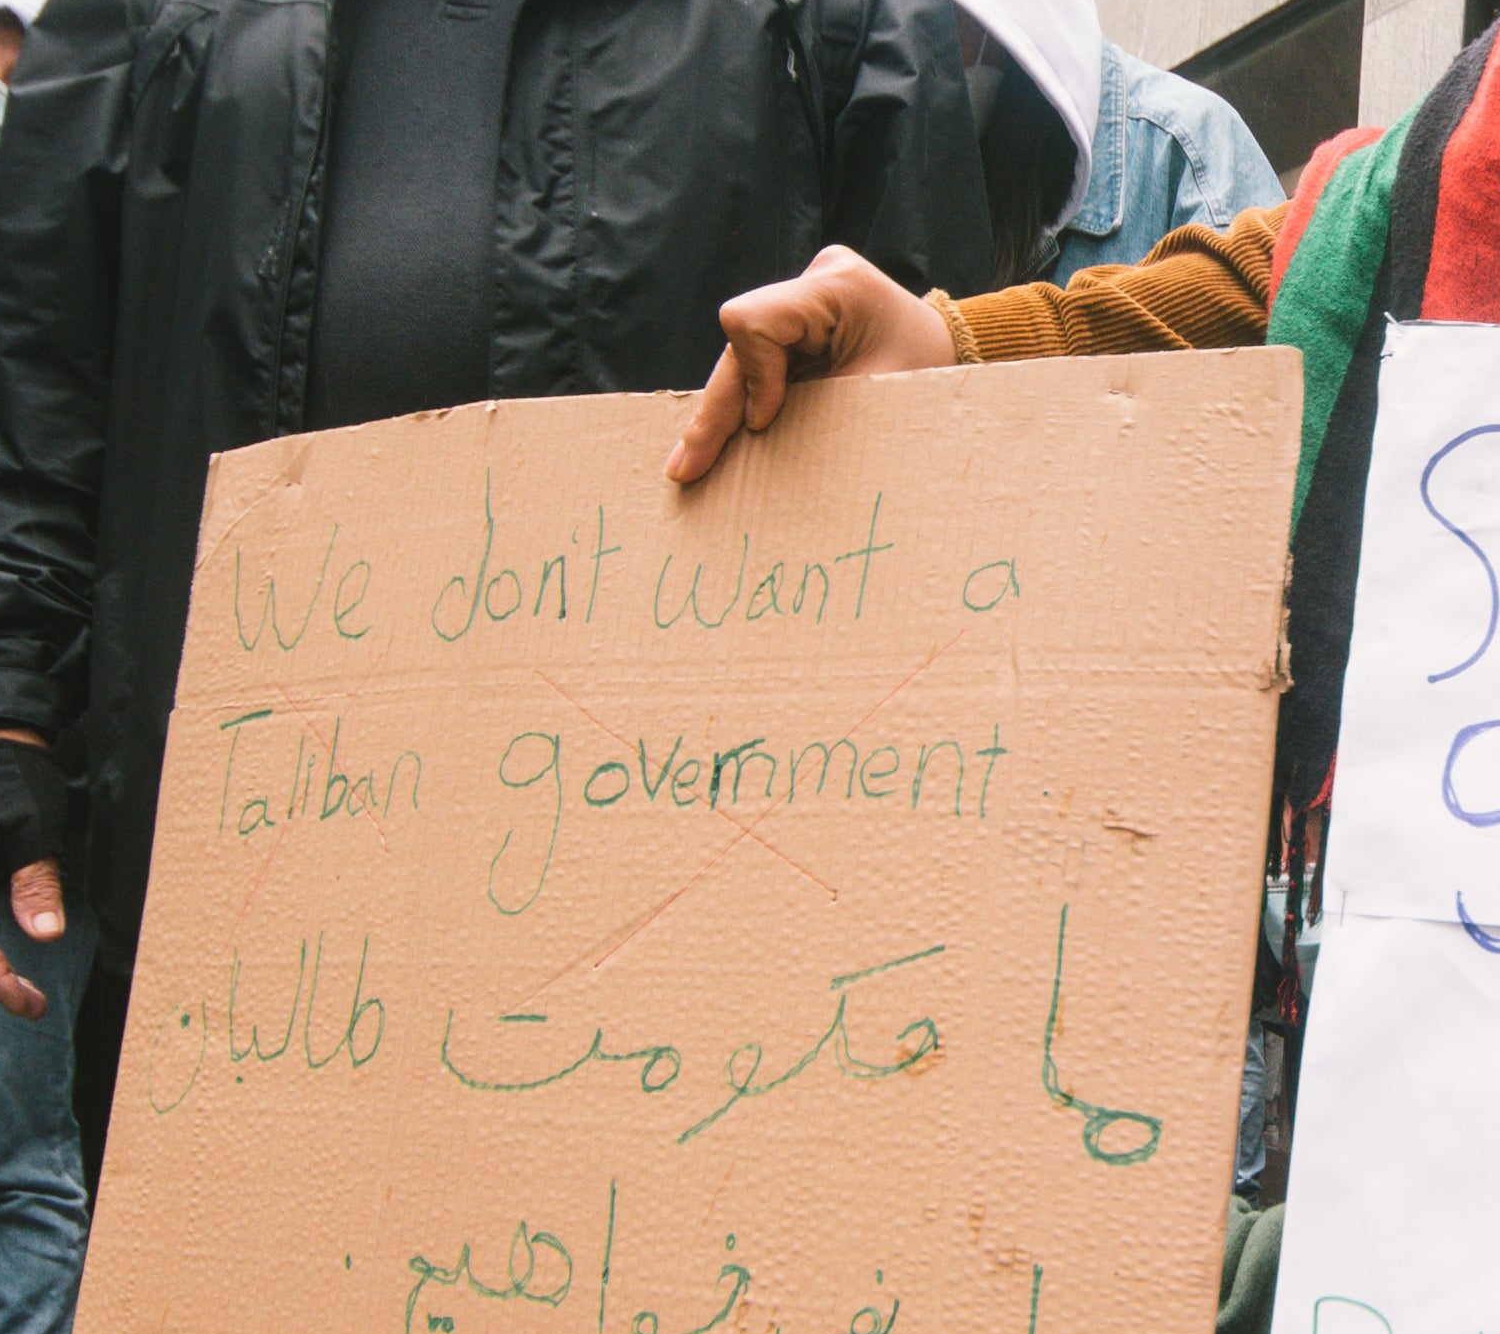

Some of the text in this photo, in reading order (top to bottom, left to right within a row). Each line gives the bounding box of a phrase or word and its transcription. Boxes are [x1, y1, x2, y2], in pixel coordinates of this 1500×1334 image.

[235, 522, 375, 652] We
[962, 556, 1022, 613] a
[217, 708, 423, 838] Taliban
[1042, 902, 1163, 1167] ما
